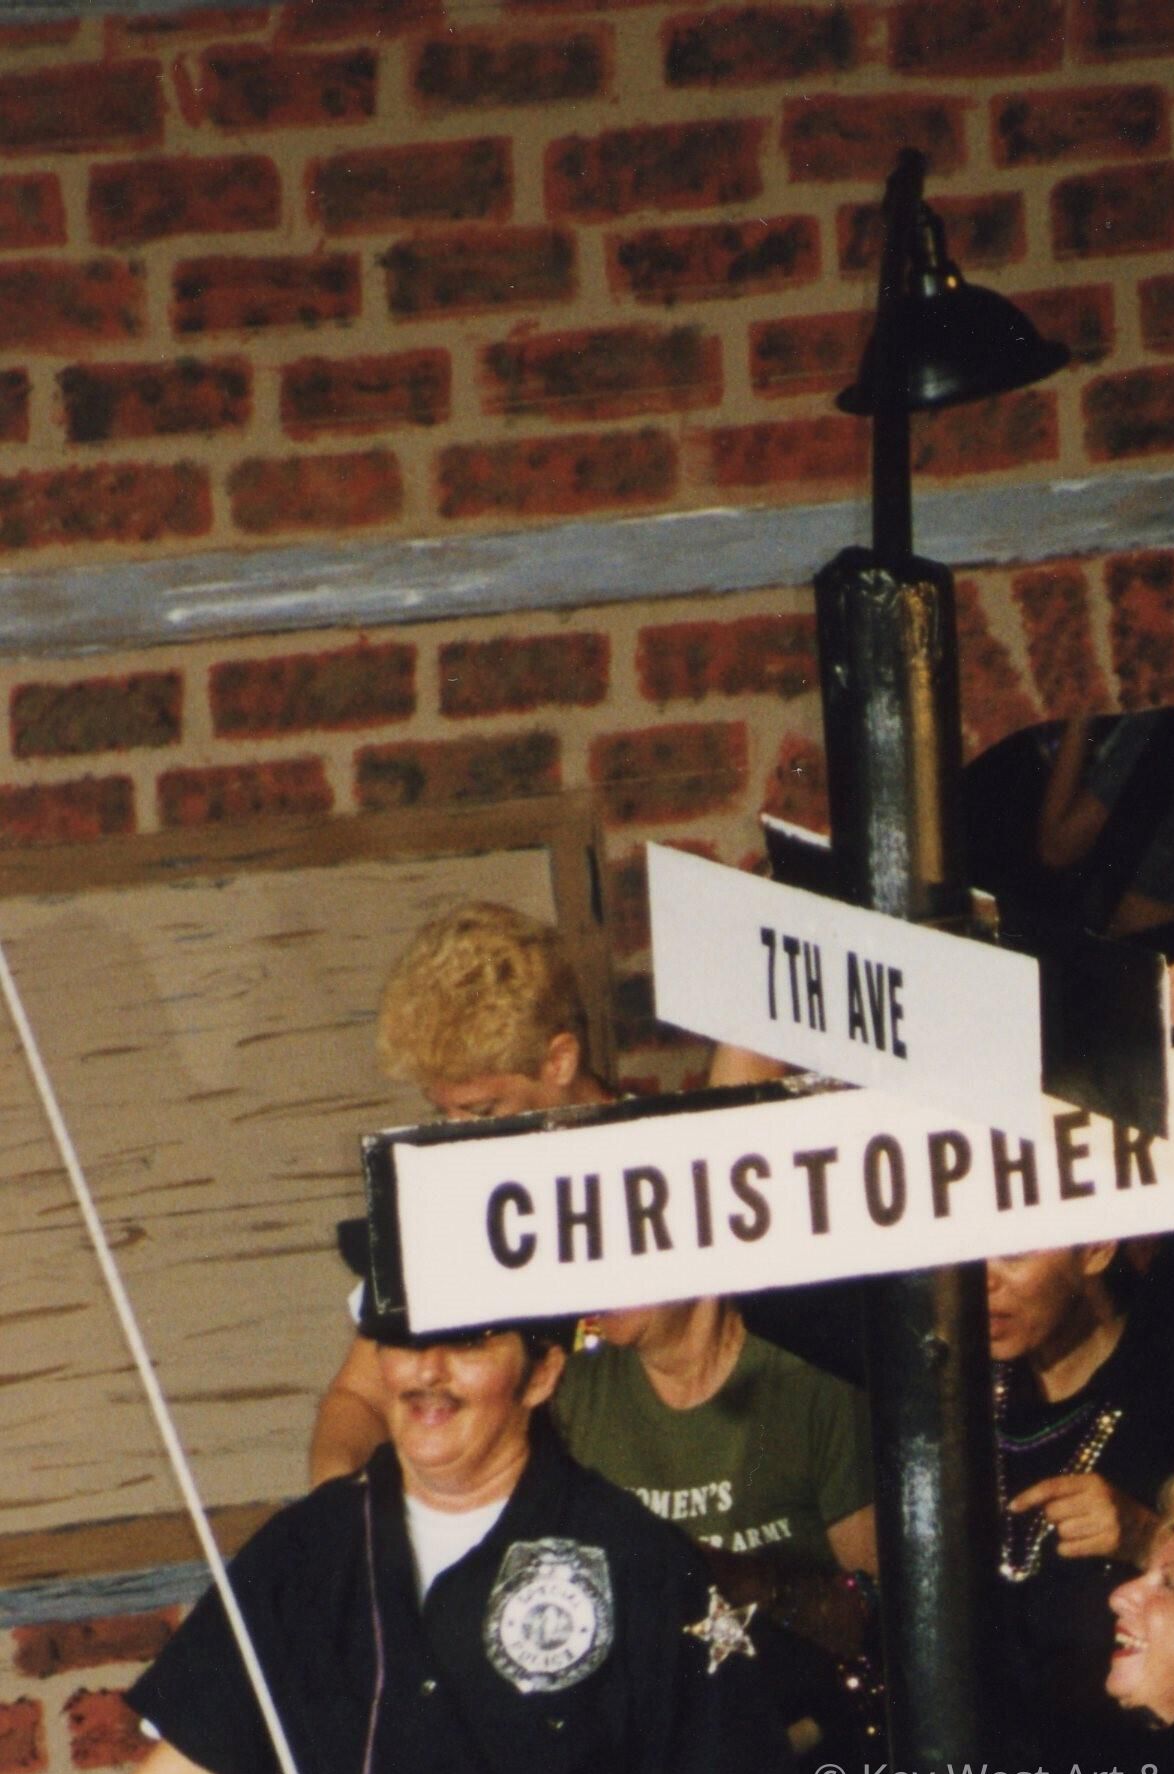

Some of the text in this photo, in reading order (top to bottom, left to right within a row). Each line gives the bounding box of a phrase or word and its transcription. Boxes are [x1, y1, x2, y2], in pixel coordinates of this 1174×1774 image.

[760, 926, 908, 1060] 7TH AVE
[486, 1111, 1158, 1269] CHRISTOPHER
[627, 1480, 733, 1520] OMEN'S
[732, 1518, 792, 1553] ARMY
